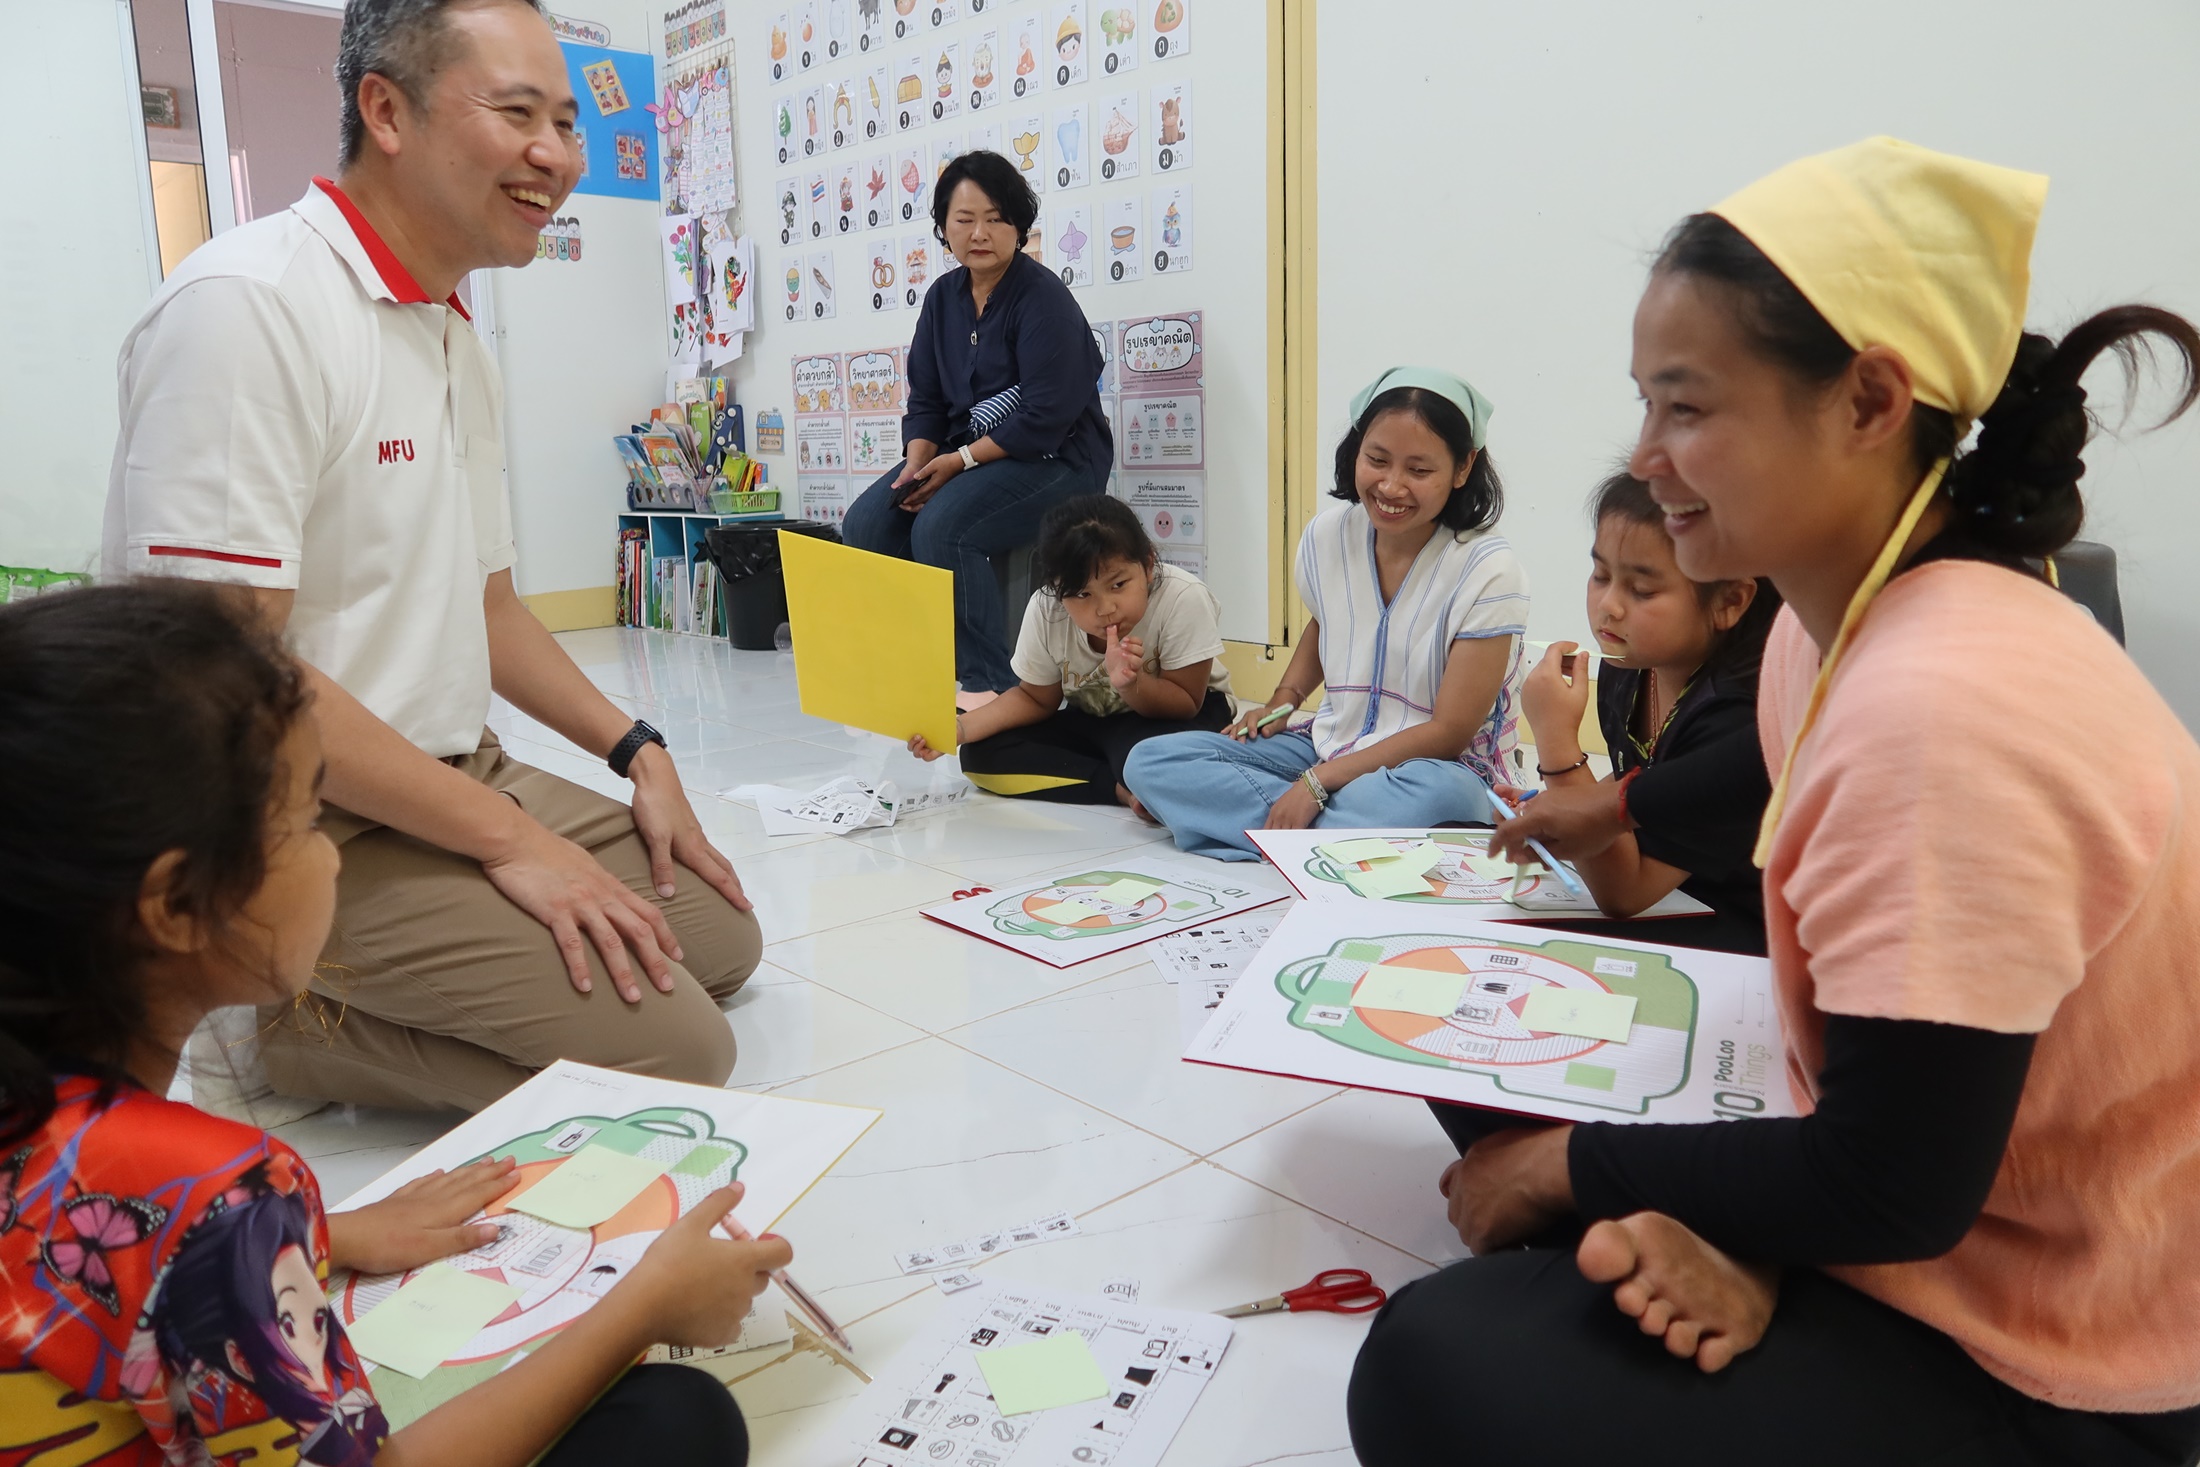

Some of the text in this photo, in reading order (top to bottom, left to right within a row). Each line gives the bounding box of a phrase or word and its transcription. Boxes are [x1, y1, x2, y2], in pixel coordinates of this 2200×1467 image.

[1126, 327, 1192, 354] รูปเรขาคณิต
[853, 364, 892, 380] วิทยาศาสตร์
[1144, 400, 1177, 412] รูปเรขาคณิต
[378, 439, 415, 465] MFU
[1222, 888, 1251, 899] 10
[1713, 1039, 1736, 1083] PooLoo
[1739, 1043, 1773, 1087] Things
[1712, 1091, 1767, 1121] 10
